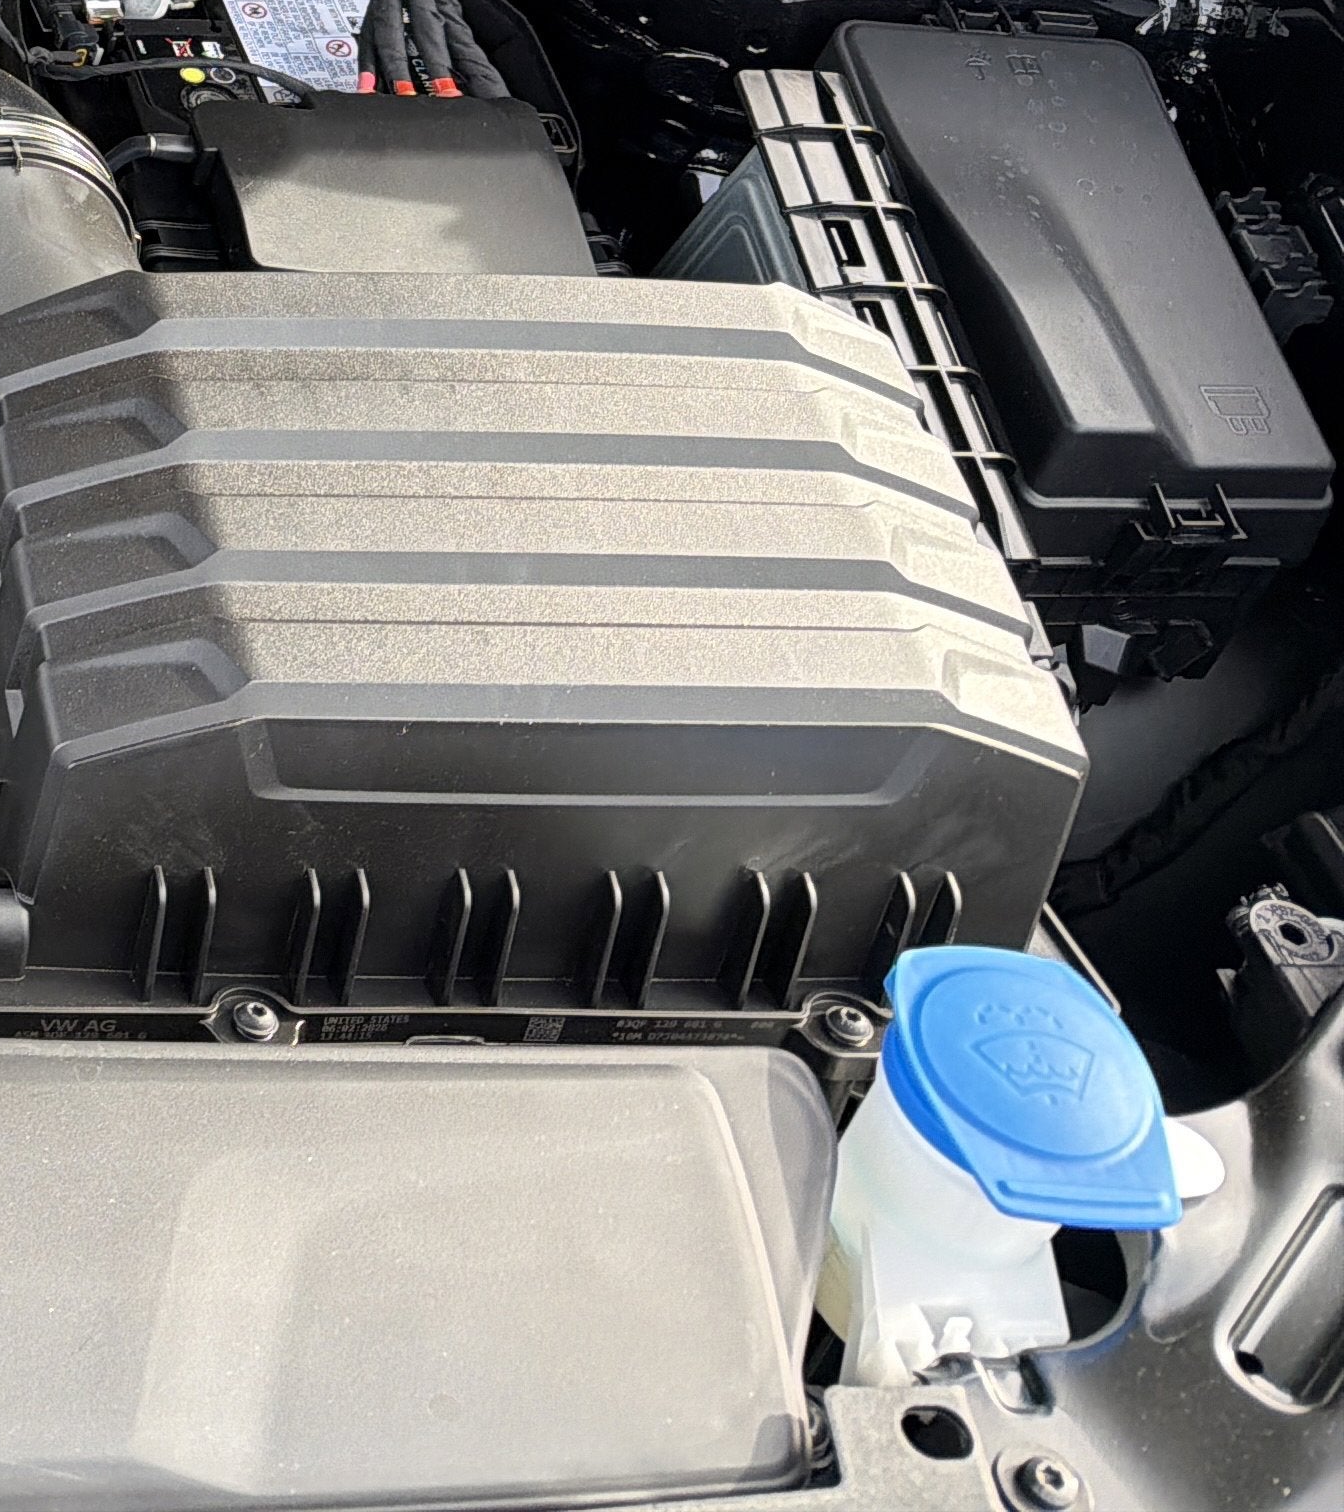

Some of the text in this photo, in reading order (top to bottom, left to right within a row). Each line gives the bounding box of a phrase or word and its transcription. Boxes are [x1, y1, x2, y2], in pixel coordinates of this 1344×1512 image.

[40, 1019, 117, 1032] VW AG
[323, 1015, 410, 1025] UNITED STATES
